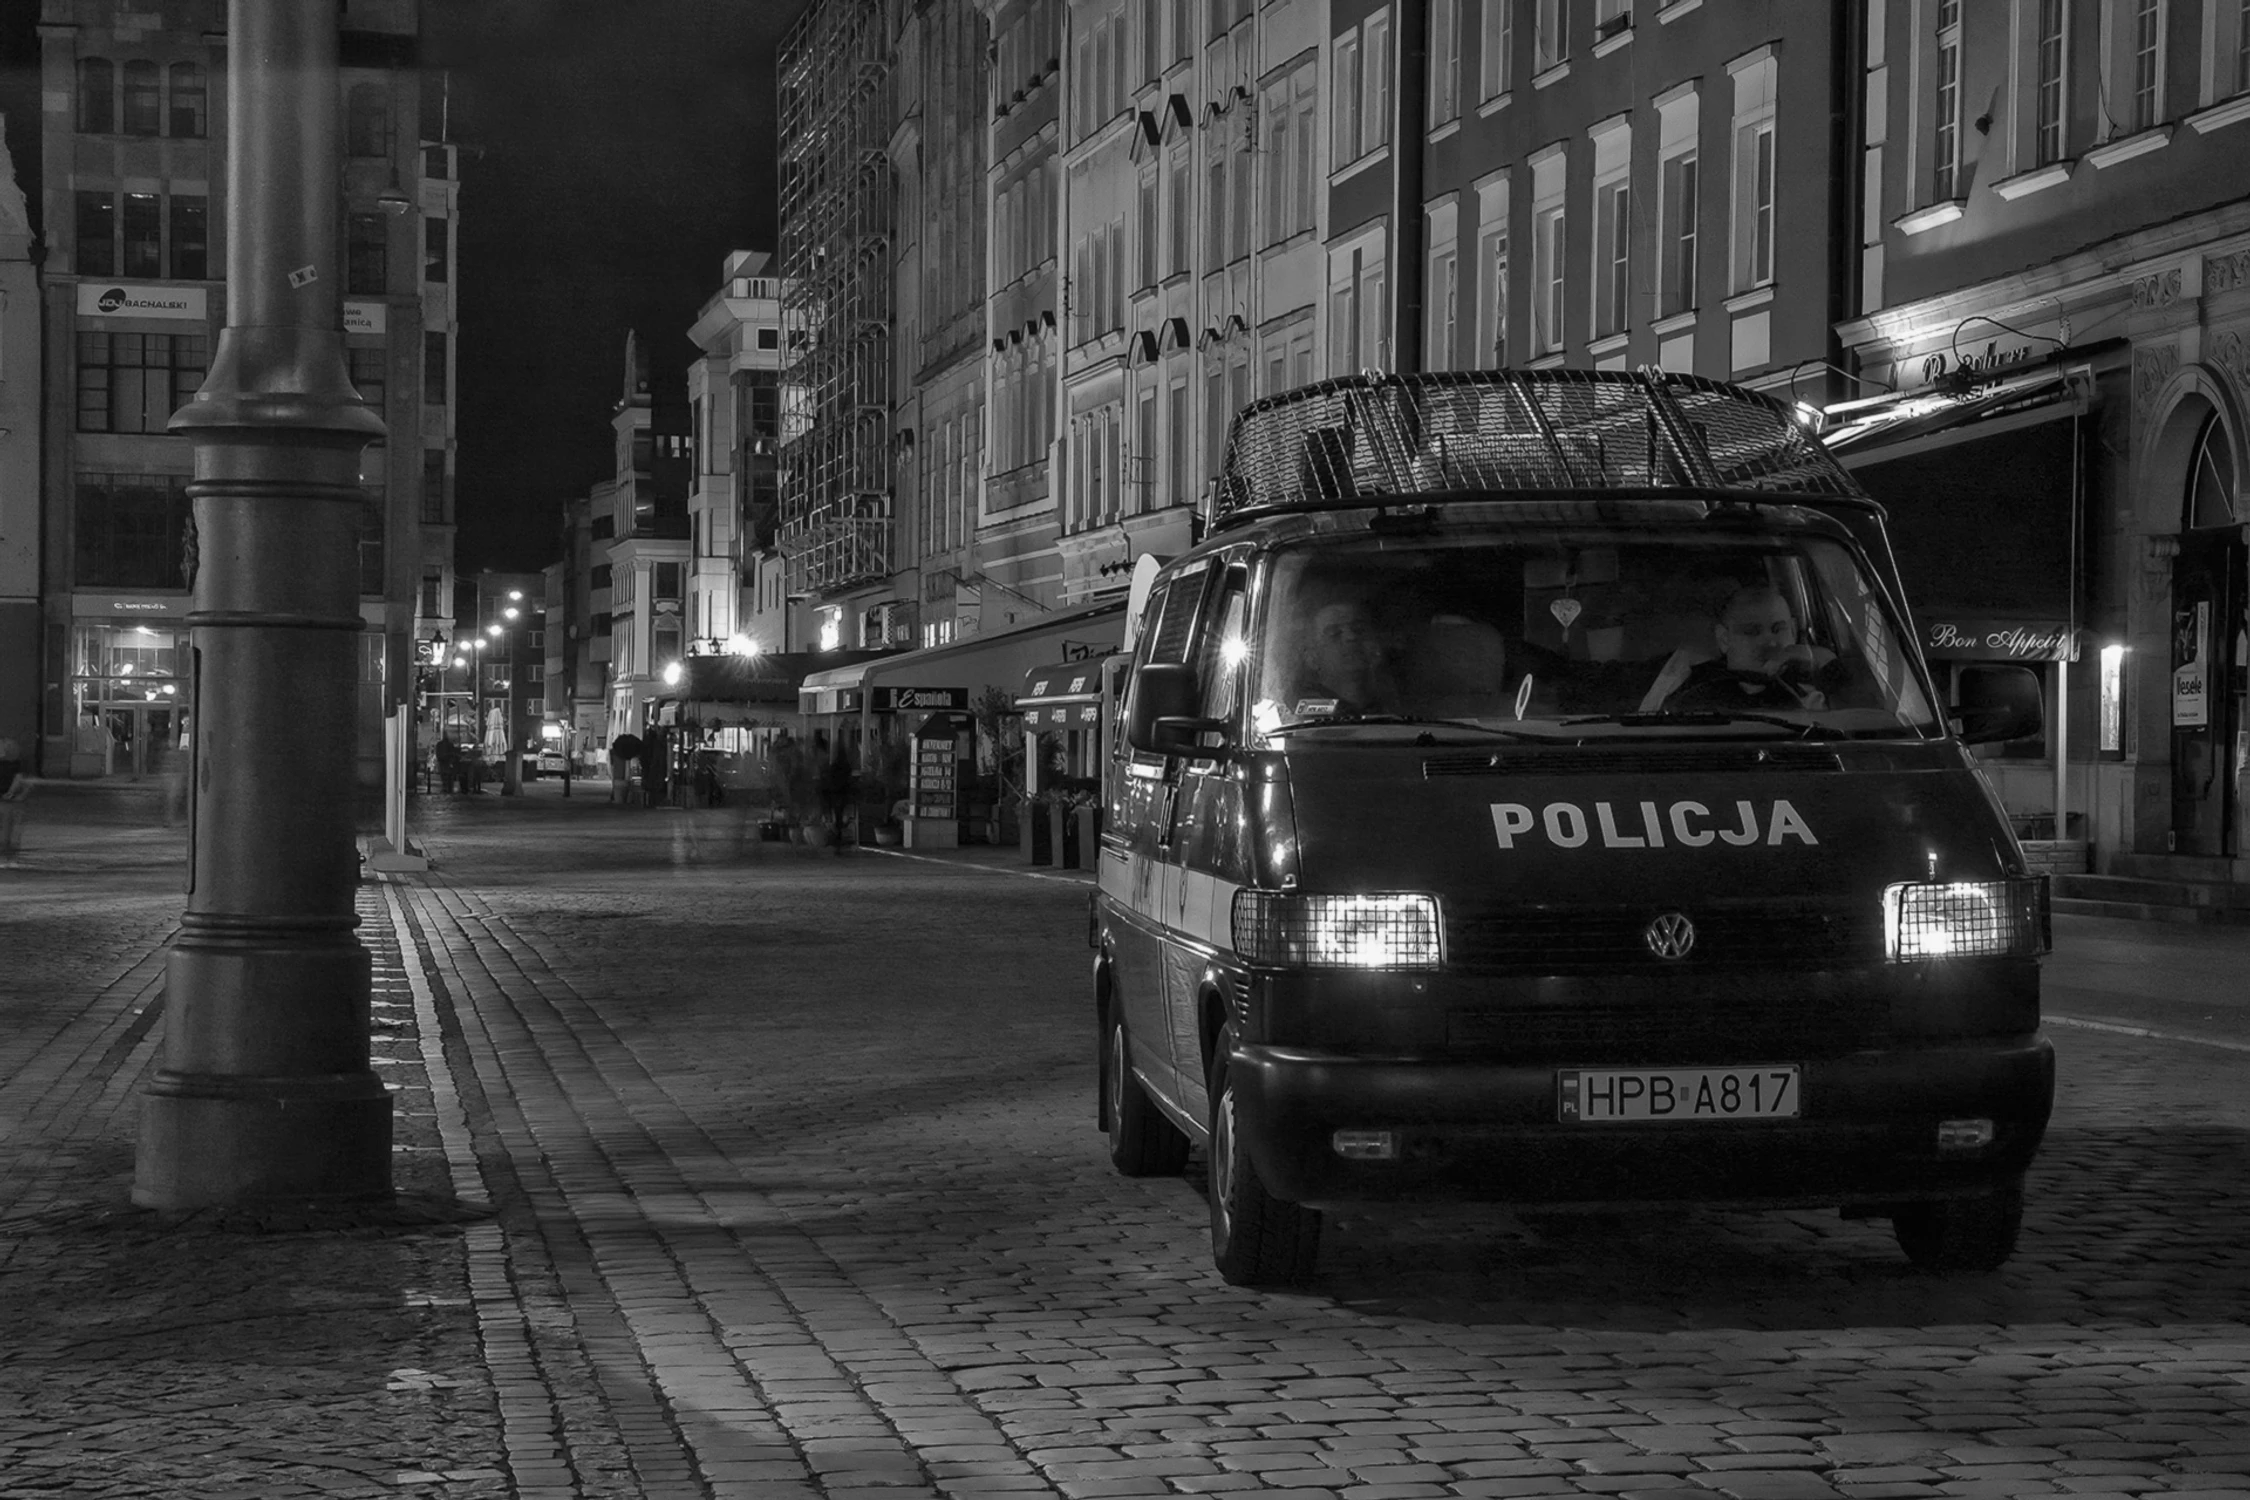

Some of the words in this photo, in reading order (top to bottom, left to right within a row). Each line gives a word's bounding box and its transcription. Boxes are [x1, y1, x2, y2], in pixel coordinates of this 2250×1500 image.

[124, 299, 188, 309] BACHALSKI
[1929, 623, 1977, 648] Bon
[1490, 800, 1819, 848] POLICJA
[1587, 1075, 1677, 1116] HPB
[1693, 1072, 1792, 1115] A817
